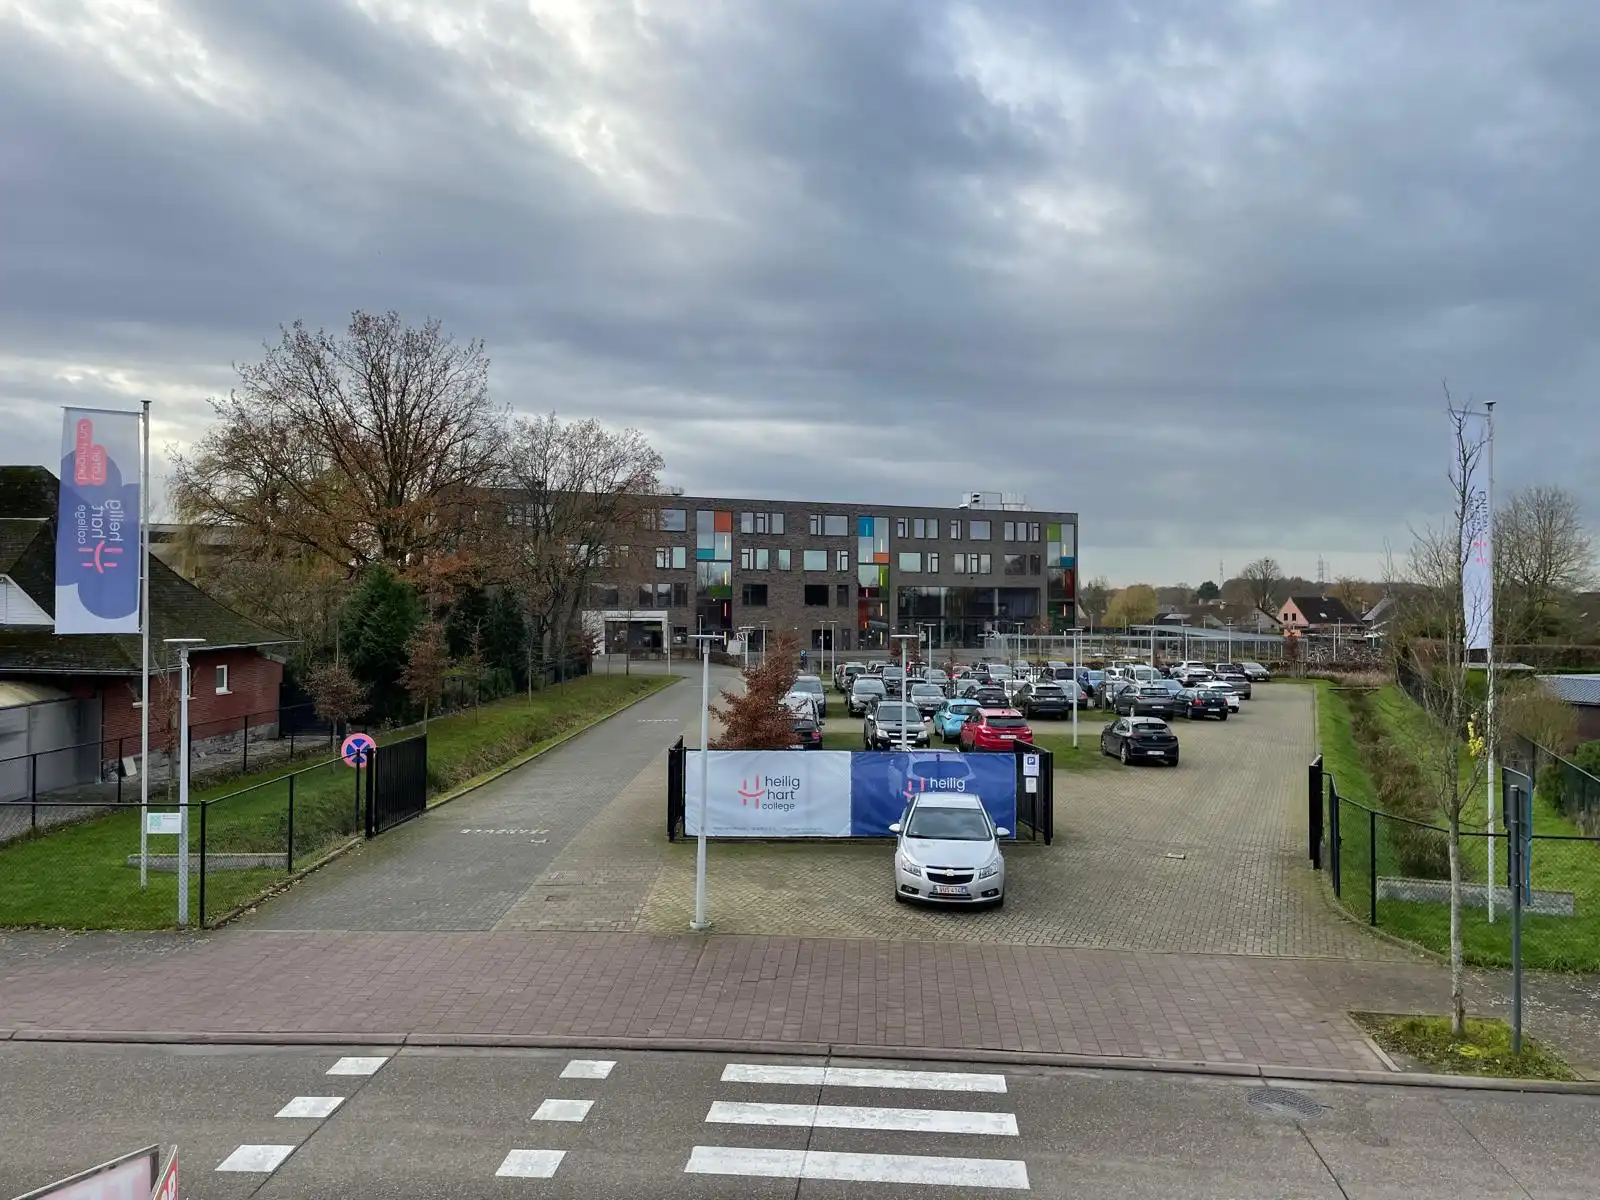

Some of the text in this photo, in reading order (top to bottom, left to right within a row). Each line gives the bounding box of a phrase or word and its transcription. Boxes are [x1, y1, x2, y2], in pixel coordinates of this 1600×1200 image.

[765, 775, 800, 790] heilig
[929, 777, 966, 792] heilig
[767, 789, 795, 800] hart
[762, 802, 795, 812] college
